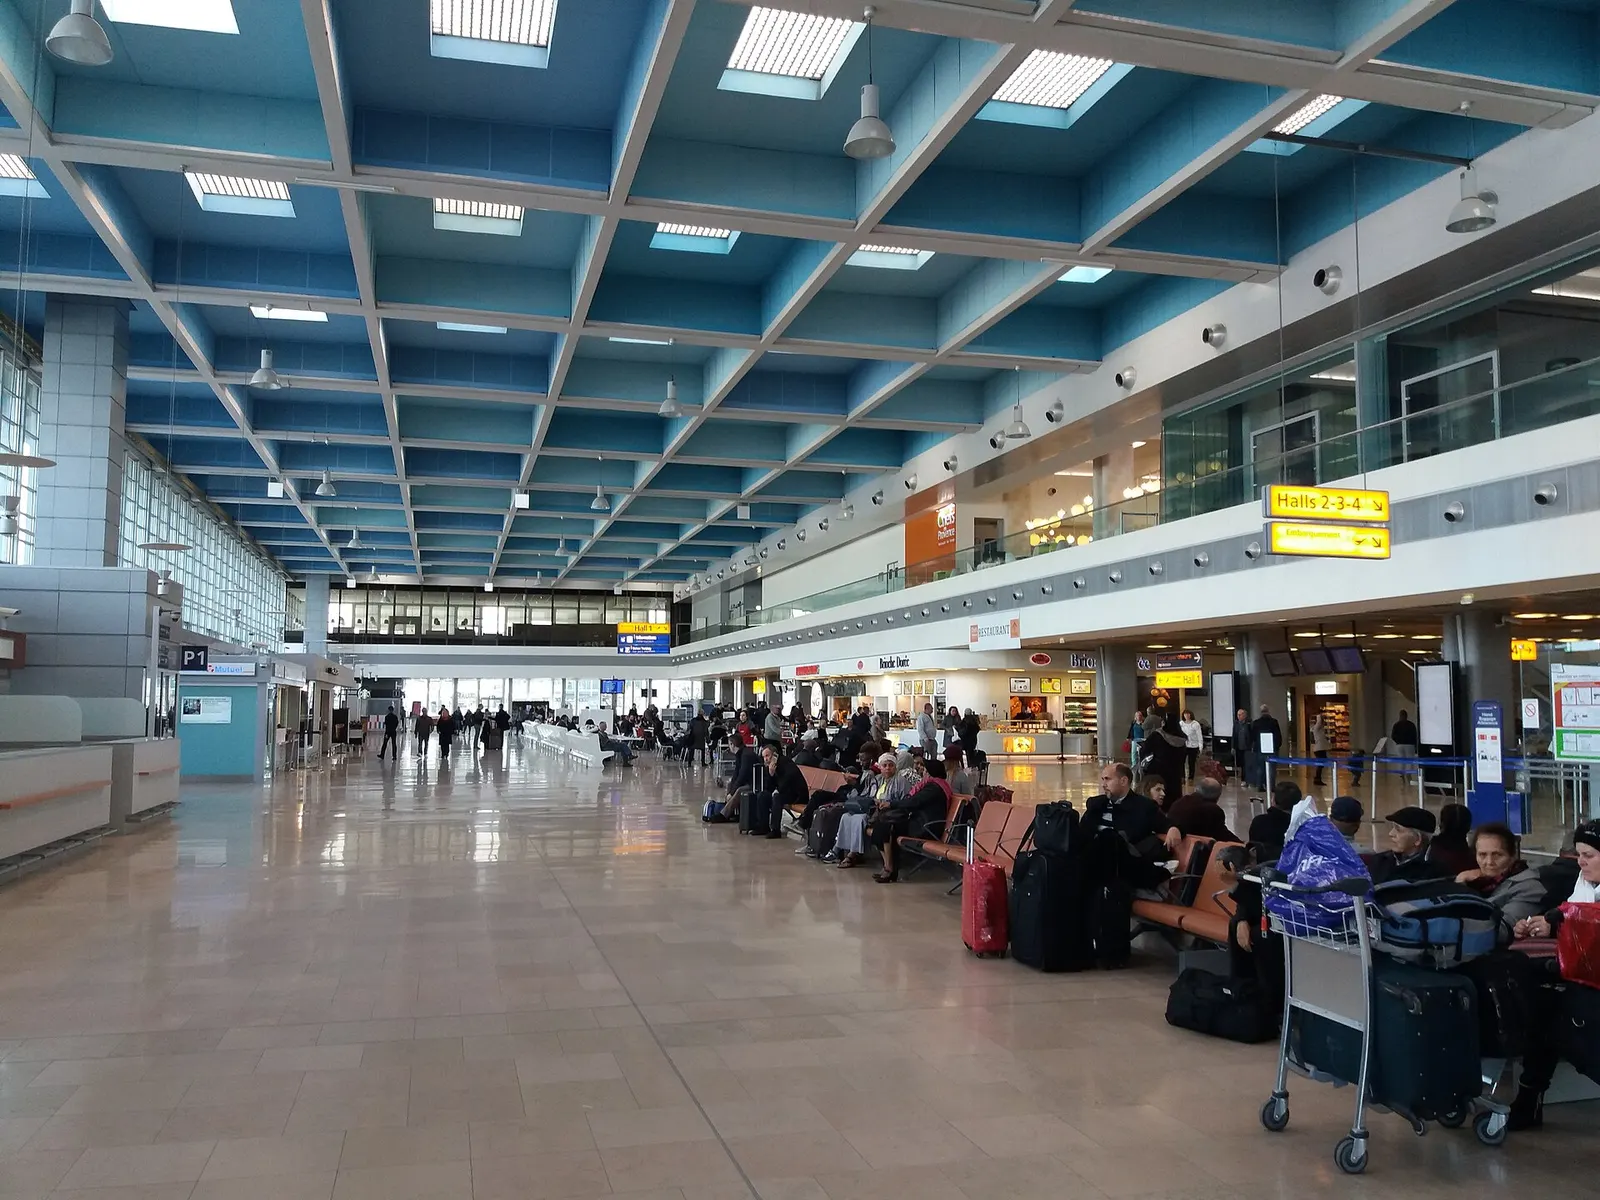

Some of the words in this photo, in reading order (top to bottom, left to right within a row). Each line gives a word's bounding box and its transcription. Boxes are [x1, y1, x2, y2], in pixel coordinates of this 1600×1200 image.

[1277, 493, 1317, 509] Halls
[1321, 495, 1361, 511] 2-3-4
[978, 624, 1010, 637] RESTAURANT
[184, 650, 206, 666] P1
[215, 665, 244, 673] Mutuel
